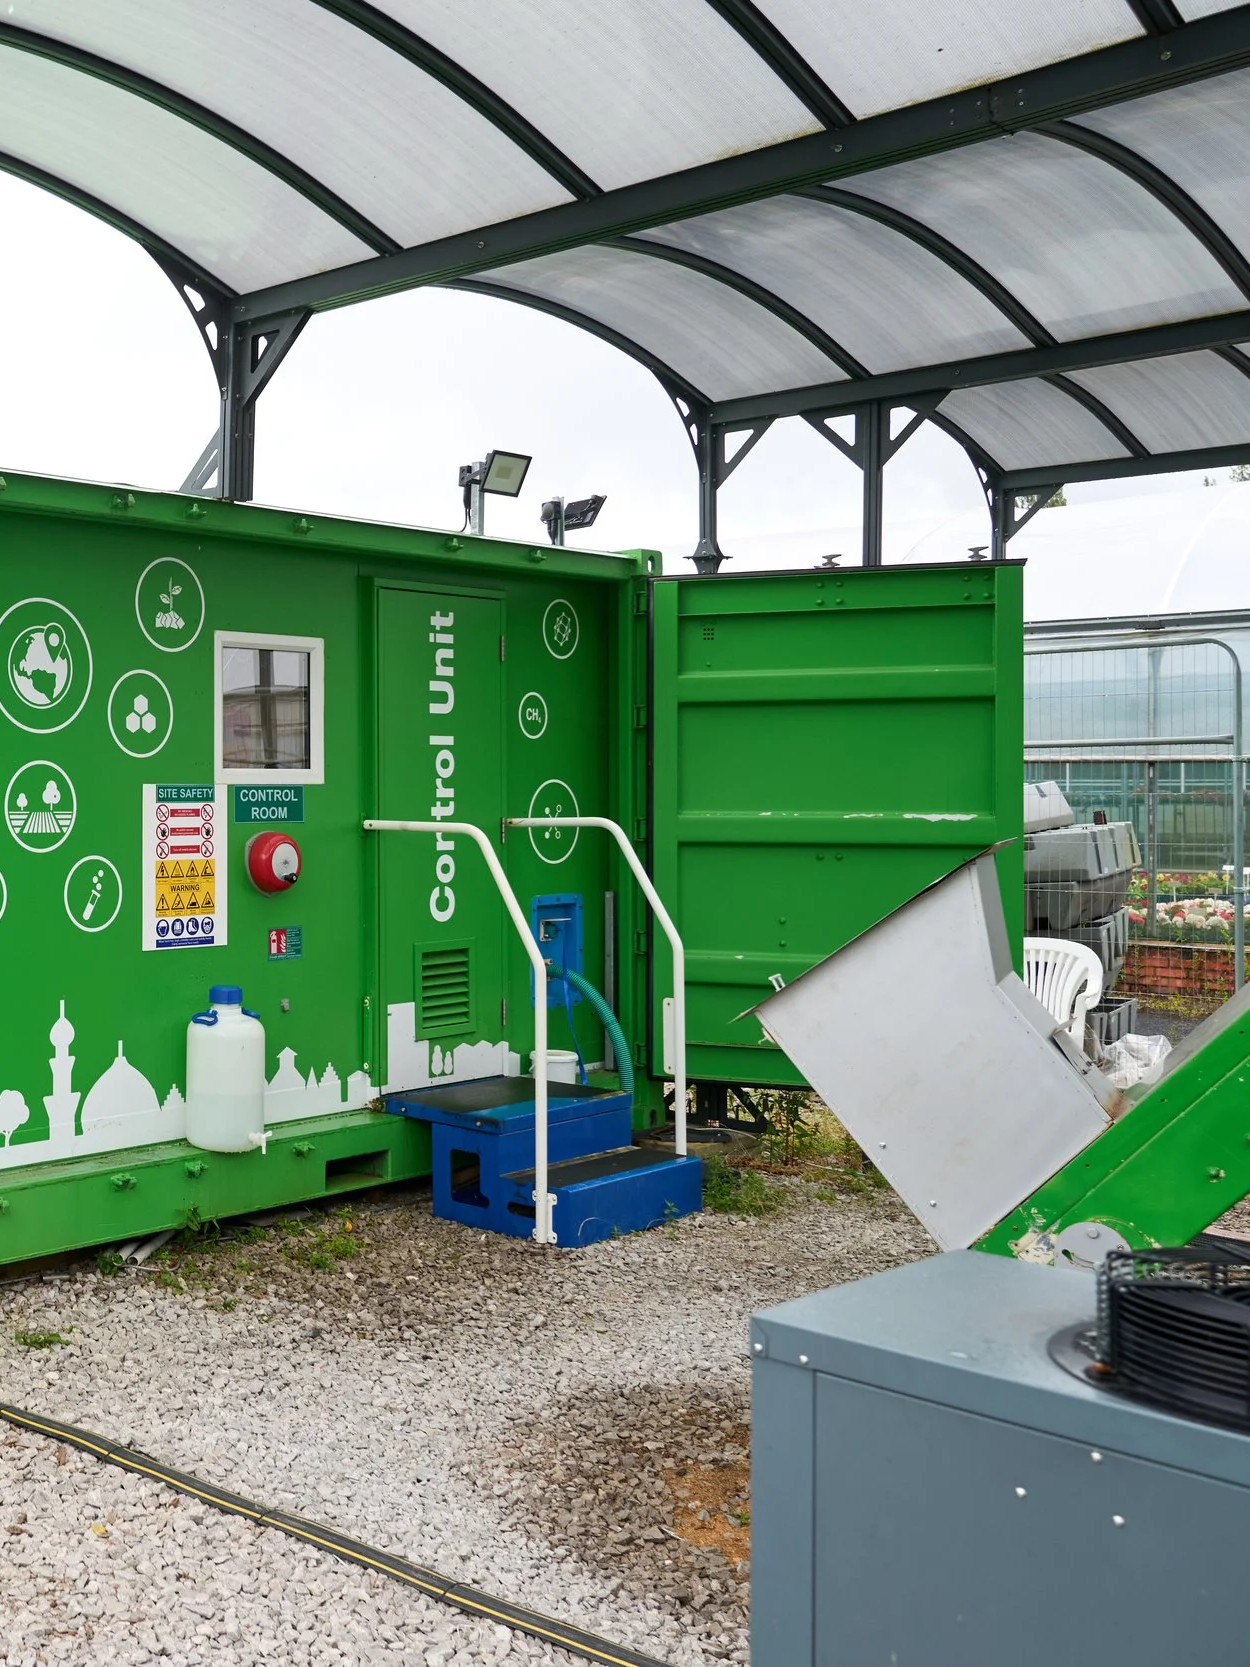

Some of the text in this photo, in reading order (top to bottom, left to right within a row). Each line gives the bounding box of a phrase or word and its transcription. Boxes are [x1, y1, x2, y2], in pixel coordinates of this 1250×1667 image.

[430, 611, 454, 714] Unit
[159, 789, 213, 798] SITE SAFETY
[240, 790, 298, 801] CONTROL
[251, 807, 287, 819] ROOM
[170, 884, 200, 892] WARNING
